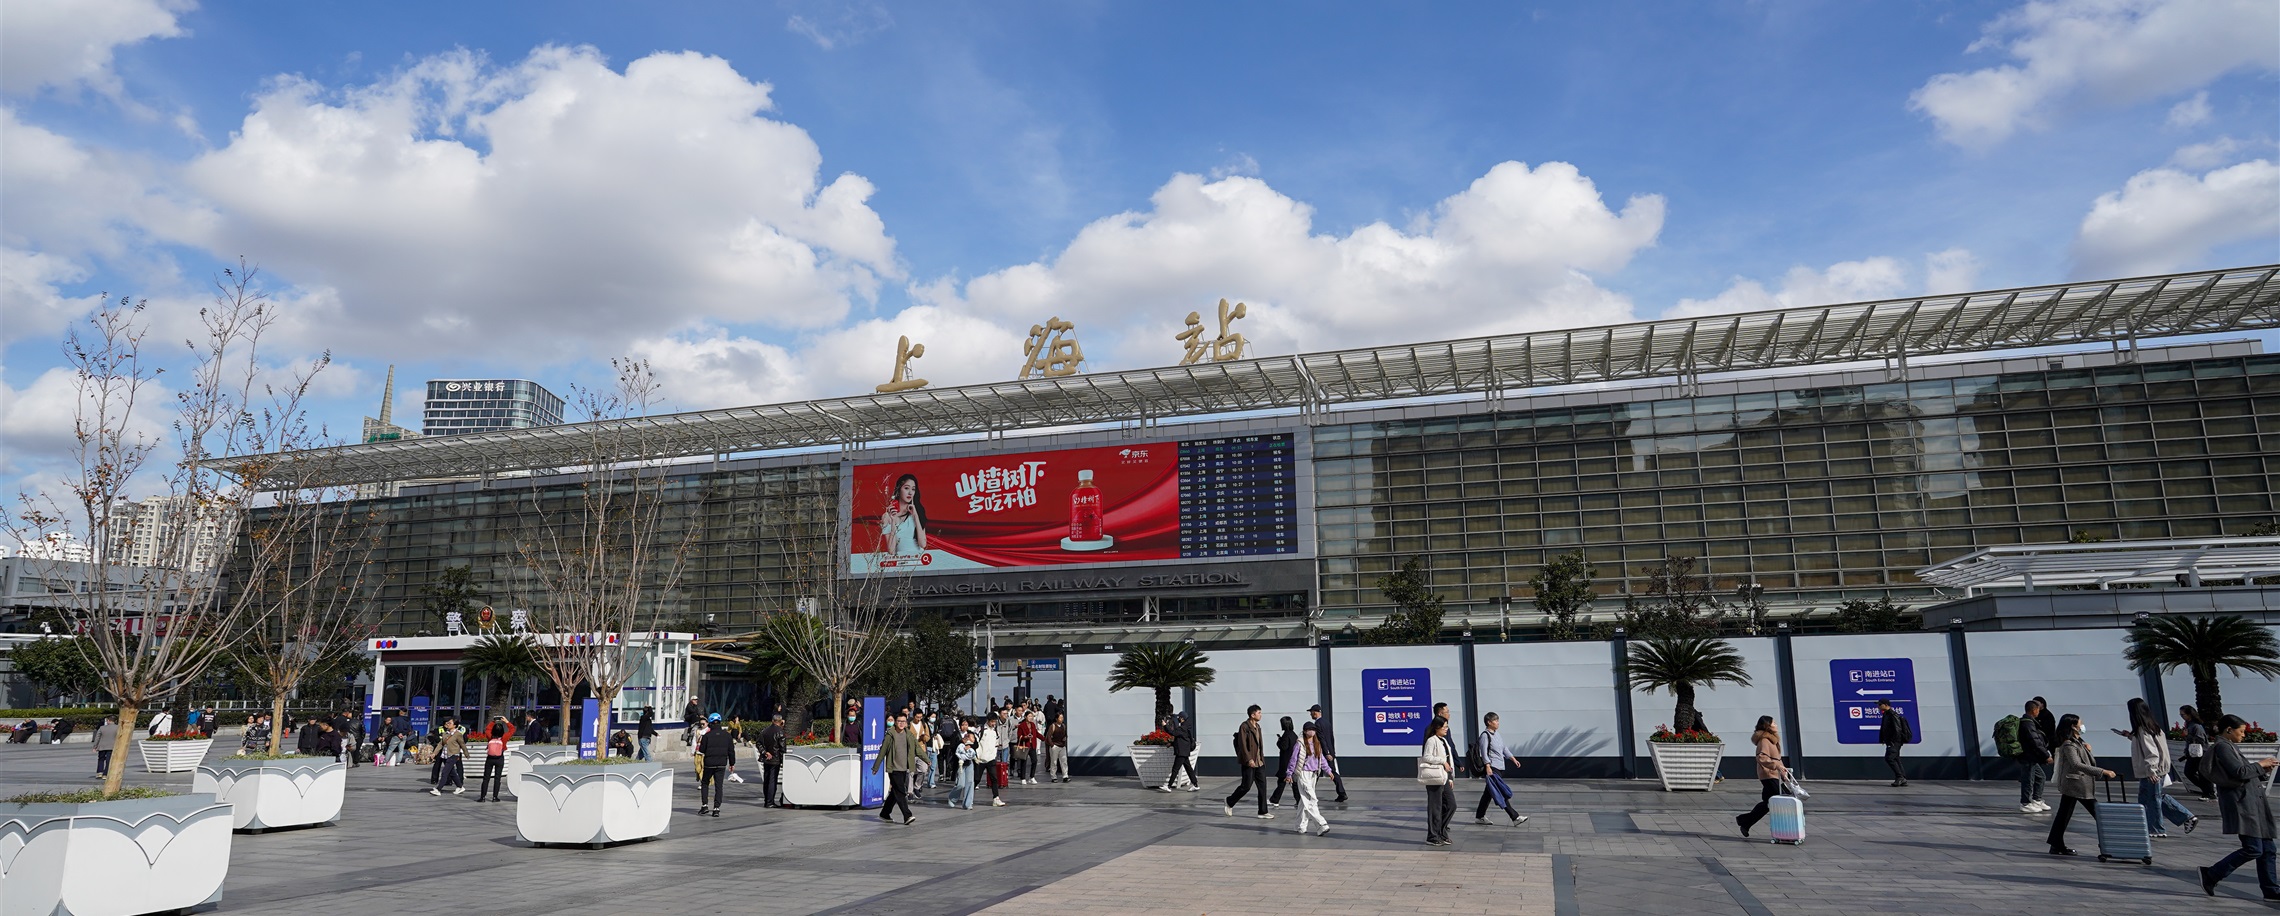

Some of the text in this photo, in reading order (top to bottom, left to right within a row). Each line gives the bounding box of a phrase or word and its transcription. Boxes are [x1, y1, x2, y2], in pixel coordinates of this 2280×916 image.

[876, 298, 1247, 393] 上海站
[462, 382, 505, 392] 兴业银行
[1132, 450, 1148, 458] 京东
[955, 461, 1046, 498] 山楂树下
[968, 486, 1037, 514] 多吃不怕
[1020, 576, 1126, 592] RAILWAY
[1140, 572, 1240, 587] STATION
